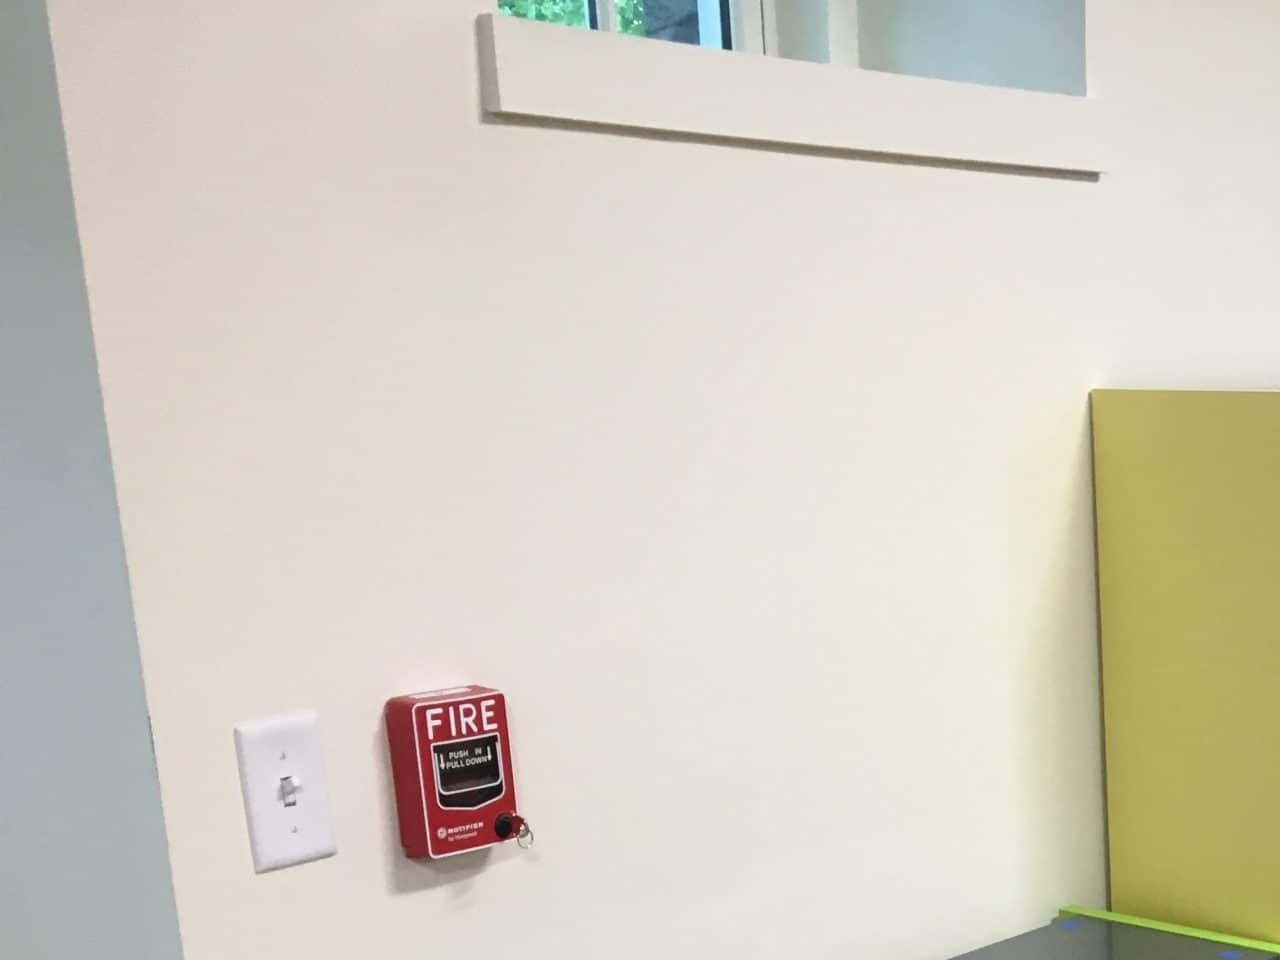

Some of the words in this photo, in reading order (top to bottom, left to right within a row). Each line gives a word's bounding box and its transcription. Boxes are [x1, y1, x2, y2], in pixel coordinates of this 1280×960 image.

[426, 699, 498, 740] FIRE
[449, 750, 469, 760] PUSH
[475, 747, 482, 755] IN
[446, 759, 465, 769] PULL
[465, 755, 488, 766] DOWN
